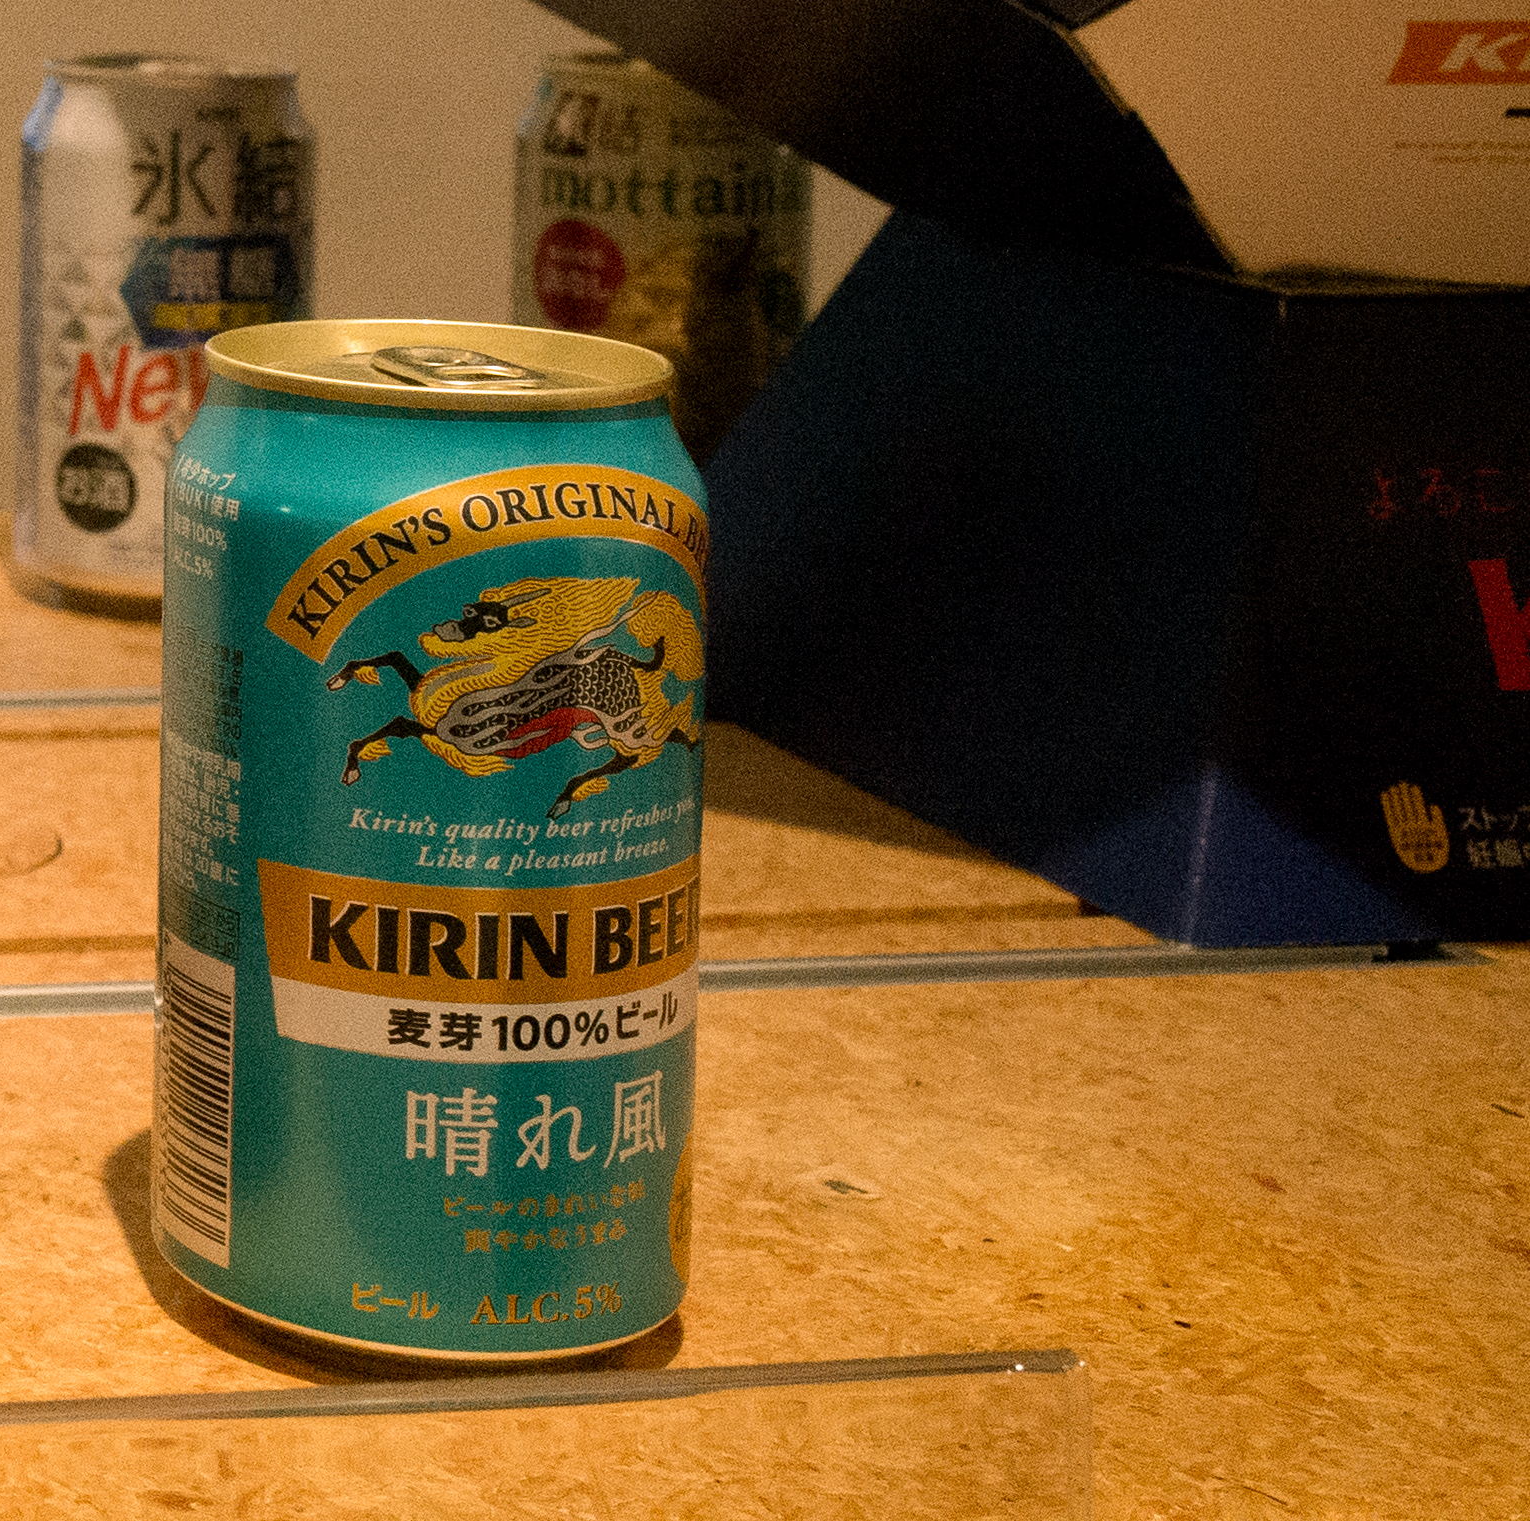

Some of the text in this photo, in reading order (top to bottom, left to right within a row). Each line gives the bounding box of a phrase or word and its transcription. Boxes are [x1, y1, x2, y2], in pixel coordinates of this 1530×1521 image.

[1441, 32, 1530, 72] K
[287, 507, 451, 640] KIRIN'S
[461, 481, 681, 537] ORIGINAL
[349, 808, 437, 836] Kirin's
[444, 819, 539, 844] quality
[546, 820, 590, 838] beer
[600, 805, 673, 838] refreshes
[416, 846, 474, 868] Like
[484, 855, 499, 870] a
[505, 849, 607, 876] pleasant
[307, 894, 570, 981] KIRIN
[387, 995, 677, 1051] 麦芽100%ビール
[405, 1070, 666, 1178] 晴れ風
[351, 1283, 438, 1319] ビール
